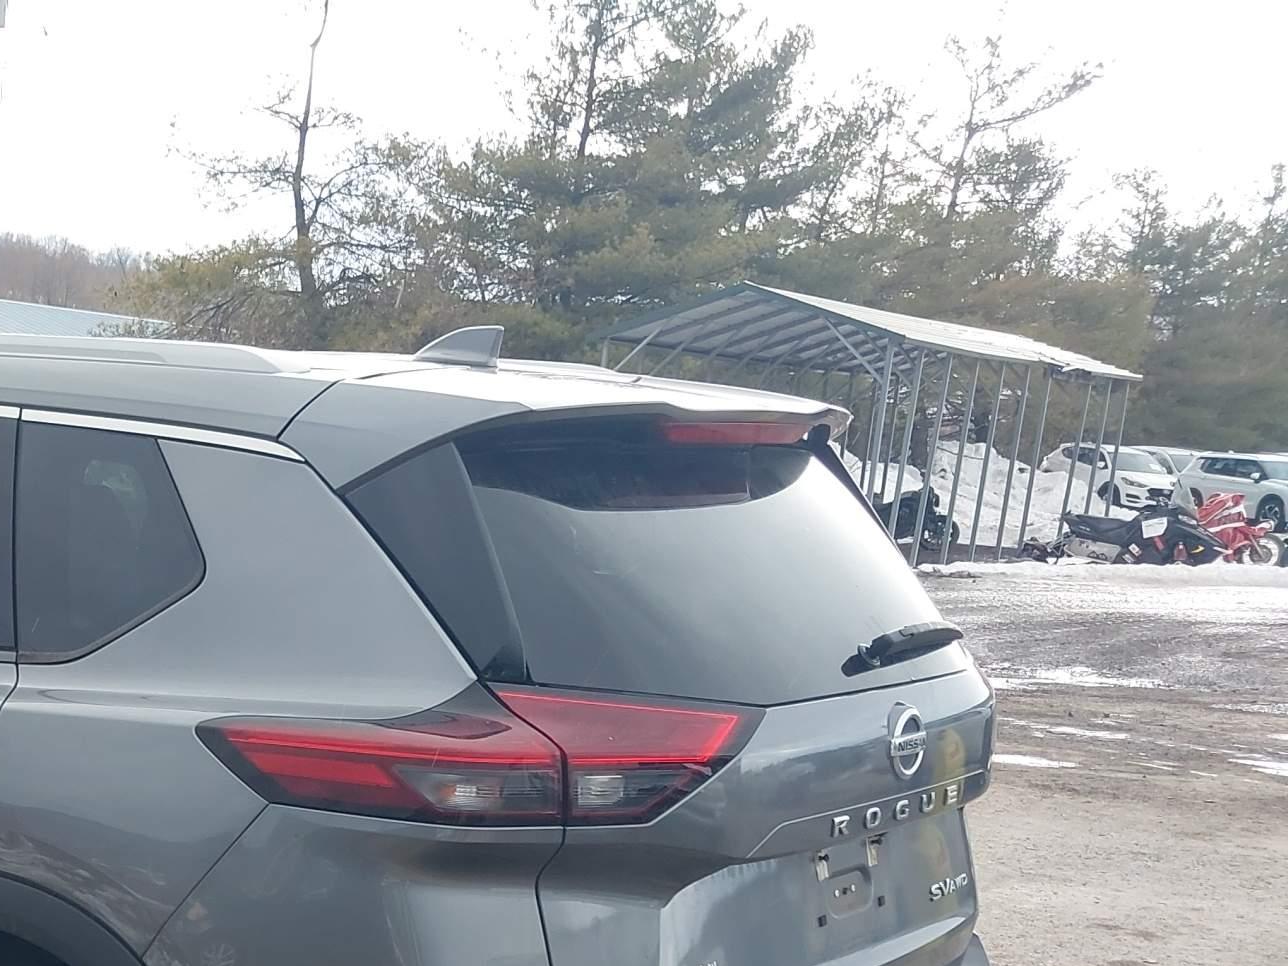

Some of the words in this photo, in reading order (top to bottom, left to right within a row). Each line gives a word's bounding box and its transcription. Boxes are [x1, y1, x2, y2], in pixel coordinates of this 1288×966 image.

[832, 784, 958, 837] ROGUE
[931, 878, 950, 900] SV
[950, 873, 968, 893] AWD
